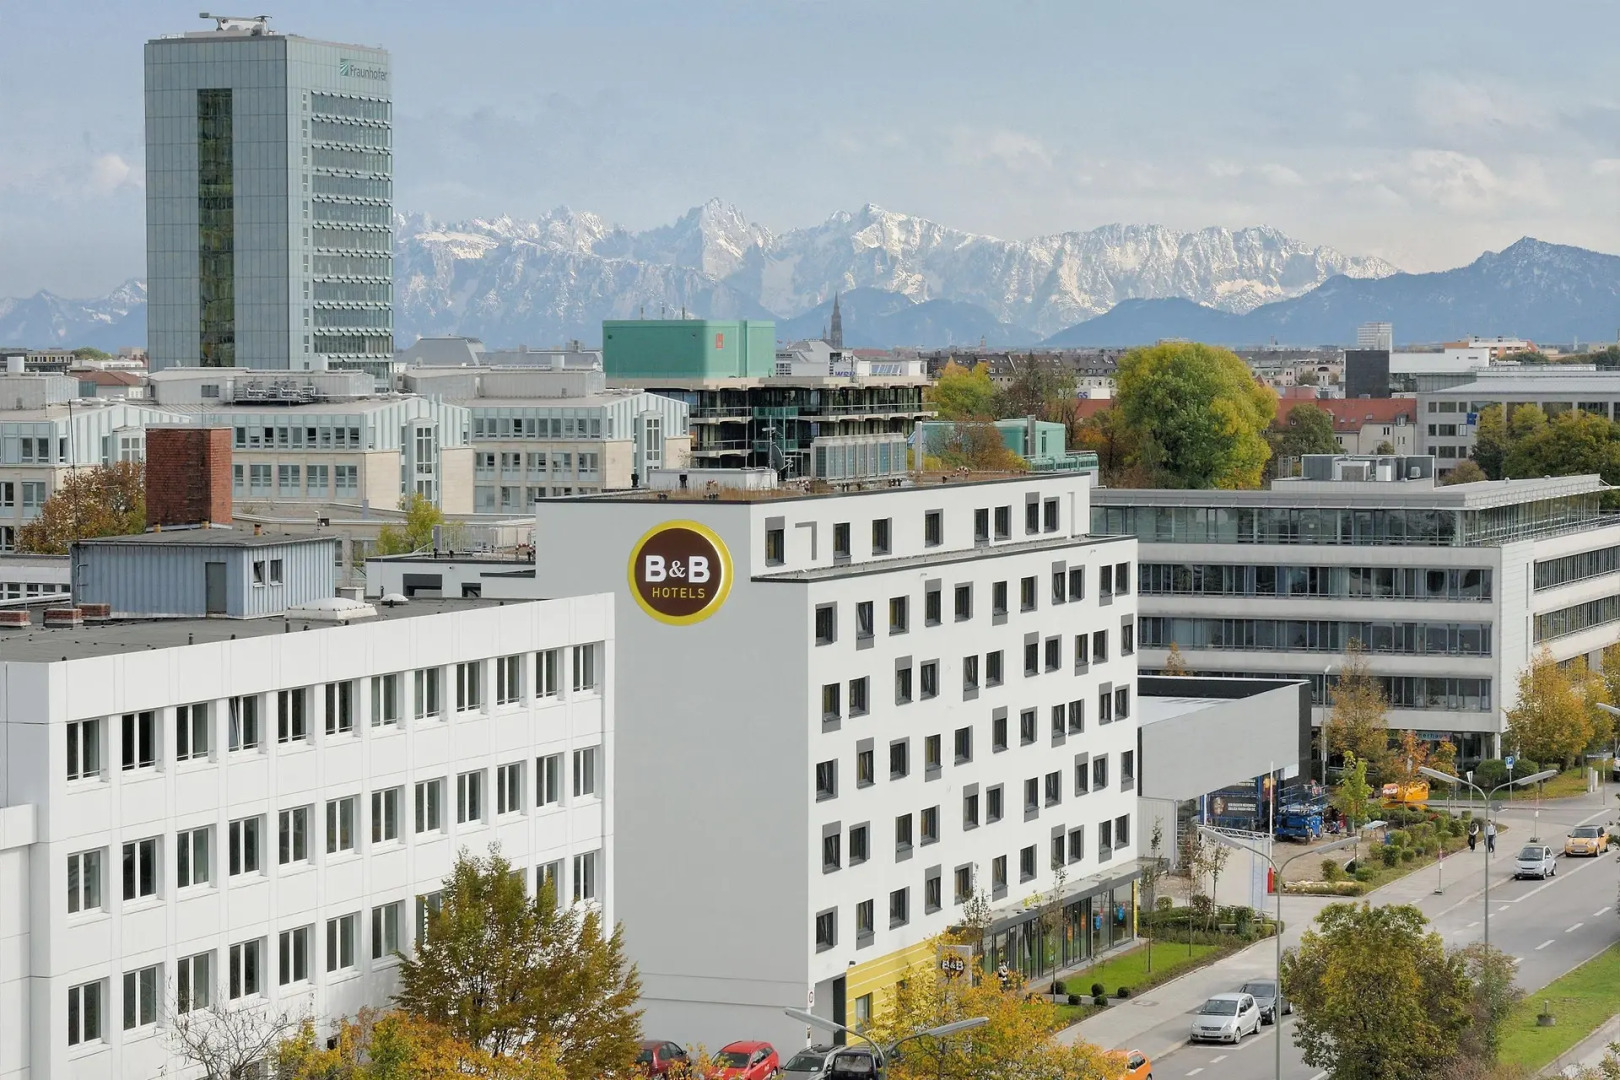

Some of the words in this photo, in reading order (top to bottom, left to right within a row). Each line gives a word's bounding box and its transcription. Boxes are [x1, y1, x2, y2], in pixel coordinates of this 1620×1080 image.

[350, 65, 388, 81] Fraunhofer
[645, 555, 711, 583] B&B
[652, 587, 706, 599] HOTELS
[942, 960, 964, 971] B&B
